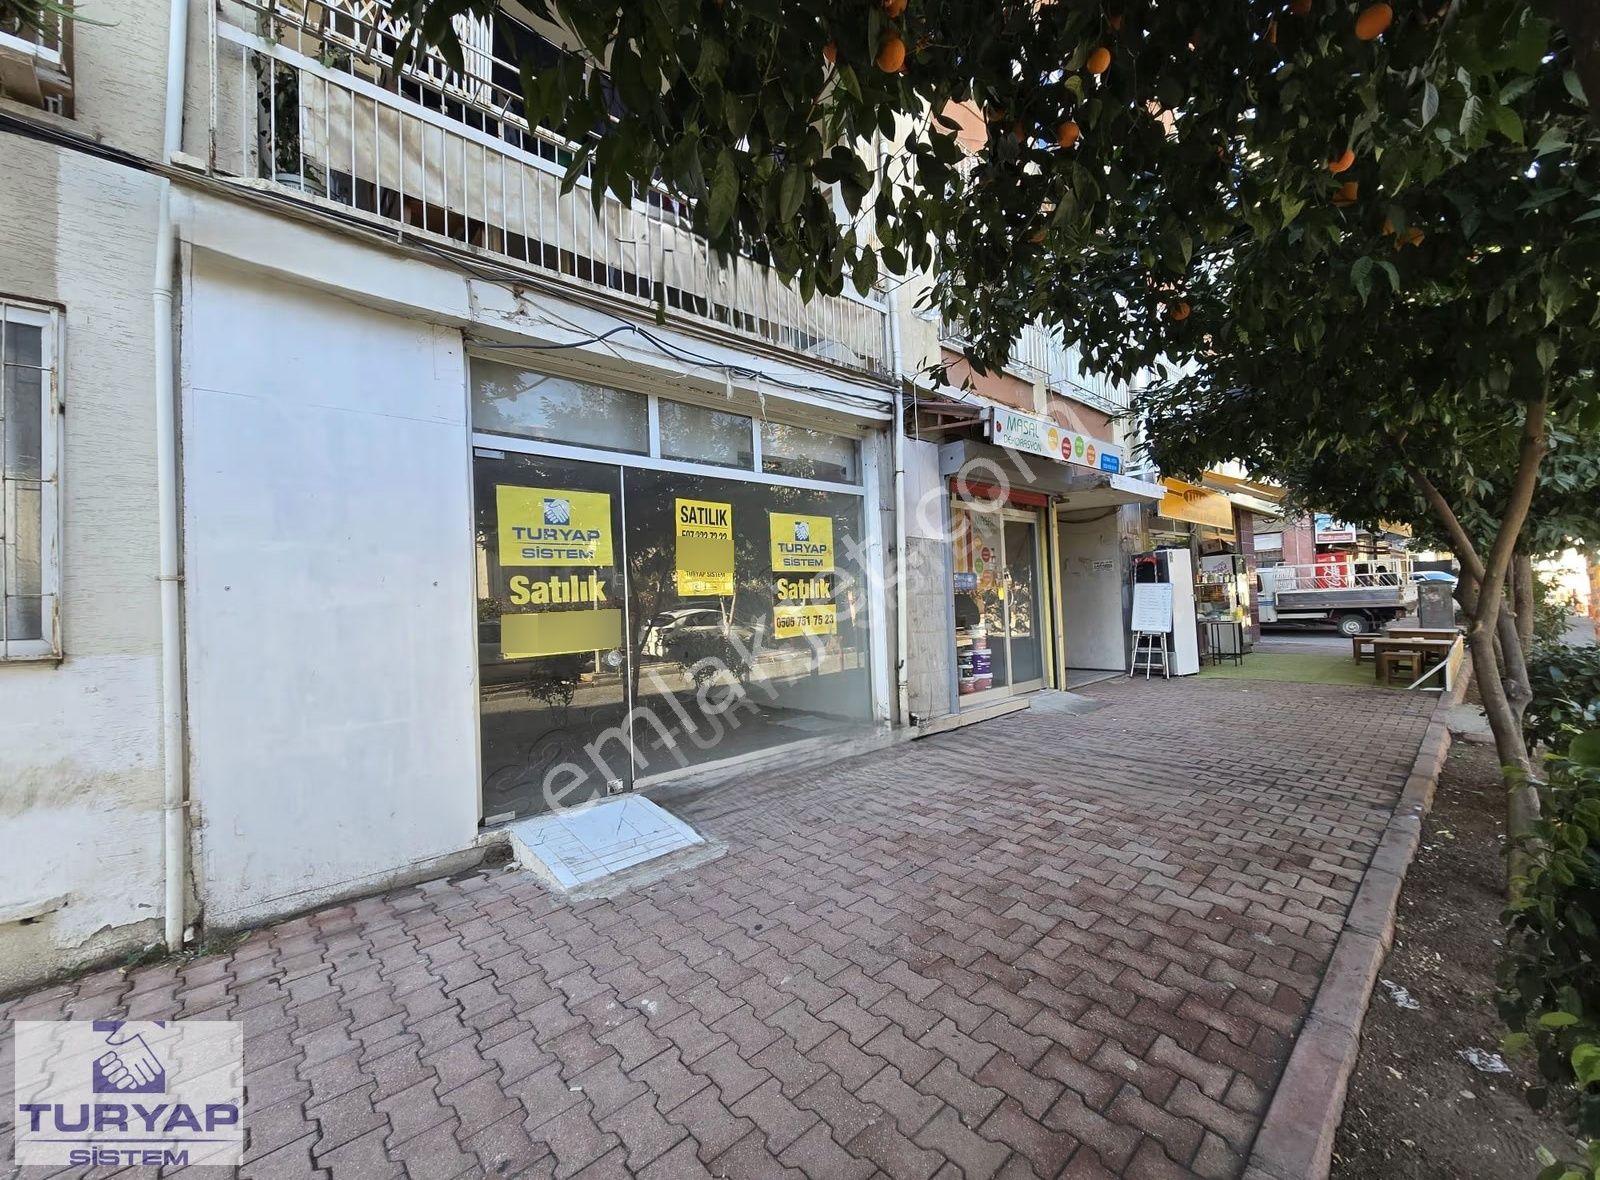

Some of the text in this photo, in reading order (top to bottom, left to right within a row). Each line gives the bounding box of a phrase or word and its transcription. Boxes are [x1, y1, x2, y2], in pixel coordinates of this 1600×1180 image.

[1006, 415, 1039, 438] MASAL
[680, 505, 728, 526] SATILIK
[511, 527, 600, 541] TURYAP
[522, 546, 594, 559] SİSTEM
[777, 543, 827, 554] TURYAP
[783, 556, 824, 567] SİSTEM
[509, 574, 608, 605] Satılık
[777, 578, 831, 600] Satılık
[813, 615, 823, 625] 75
[825, 614, 835, 625] 23
